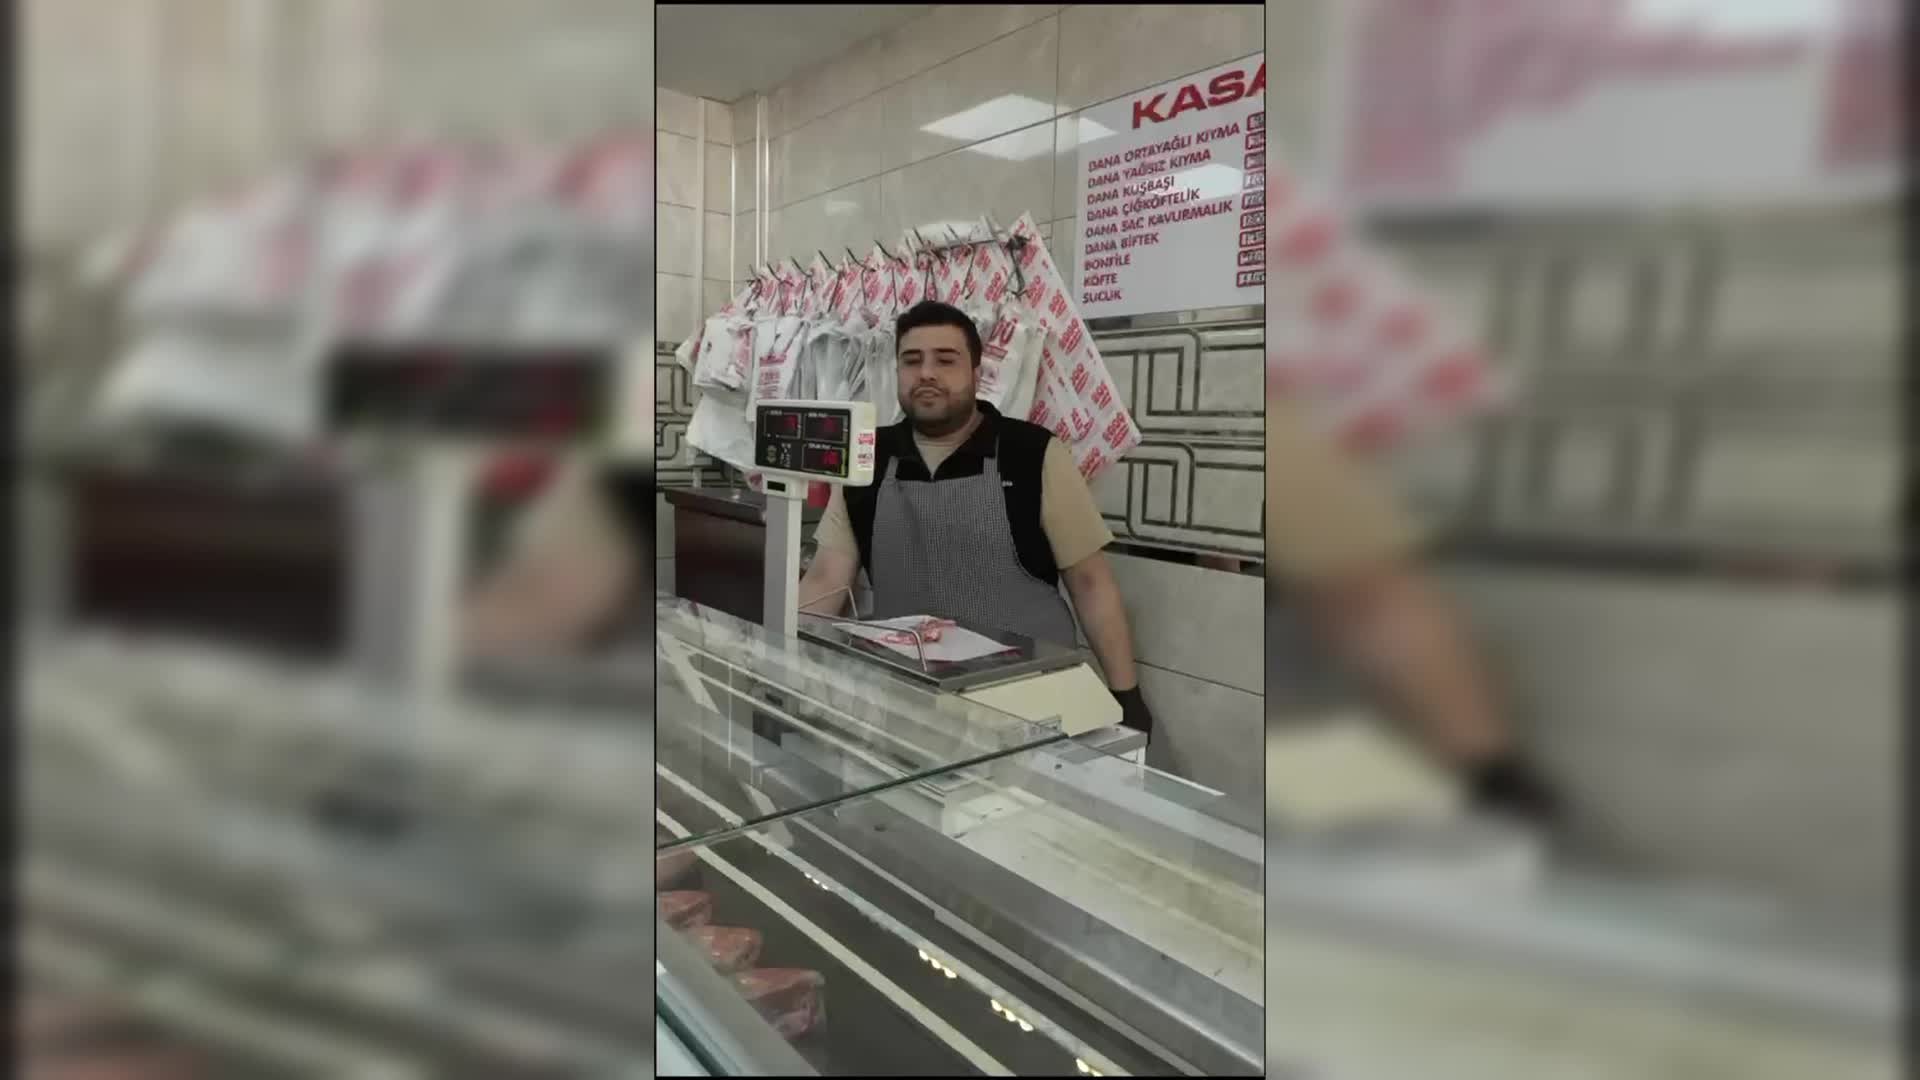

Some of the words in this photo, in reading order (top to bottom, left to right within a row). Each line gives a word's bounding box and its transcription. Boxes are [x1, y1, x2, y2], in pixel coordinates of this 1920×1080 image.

[1088, 155, 1121, 172] DANA
[1124, 135, 1192, 163] ORTAYAĞLI
[1195, 122, 1240, 144] KIYMA
[1088, 172, 1120, 189] DANA
[1122, 158, 1166, 179] YAĞSIZ
[1169, 149, 1211, 169] KIYMA
[1087, 188, 1119, 206] DANA
[1123, 176, 1175, 198] KUŞBAŞI
[1085, 223, 1118, 238] DANA
[1121, 216, 1144, 232] SAC
[1148, 200, 1233, 227] KAVURMALIK
[1087, 206, 1119, 222] DANA
[1085, 240, 1117, 255] DANA
[1120, 232, 1160, 248] BİFTEK
[1084, 254, 1130, 271] BONFİLE
[1082, 290, 1122, 304] SUCUK
